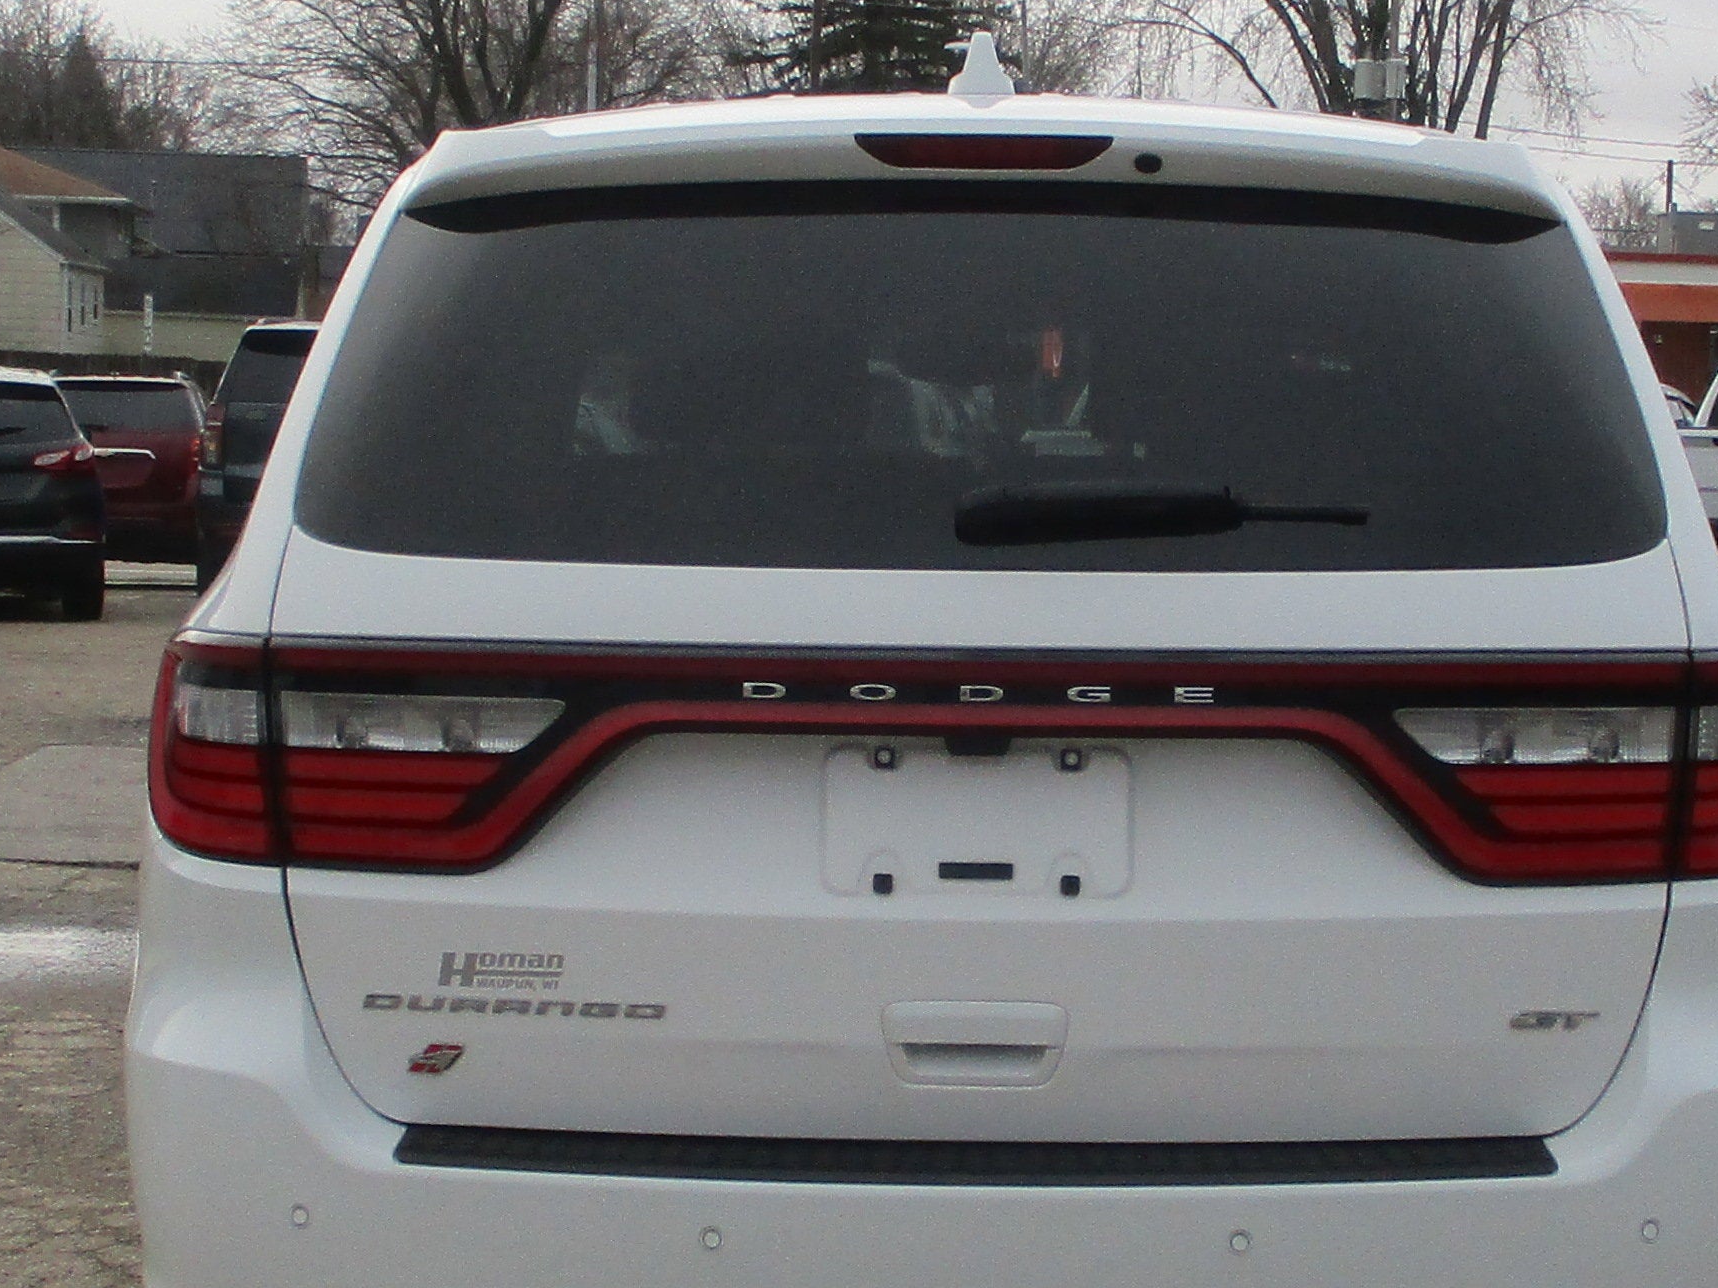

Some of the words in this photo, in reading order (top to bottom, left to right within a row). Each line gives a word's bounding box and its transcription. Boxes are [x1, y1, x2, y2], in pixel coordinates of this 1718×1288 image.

[742, 681, 1215, 703] DODGE
[438, 951, 565, 987] Homan
[363, 993, 669, 1019] DURANGO
[1509, 1010, 1601, 1031] GT
